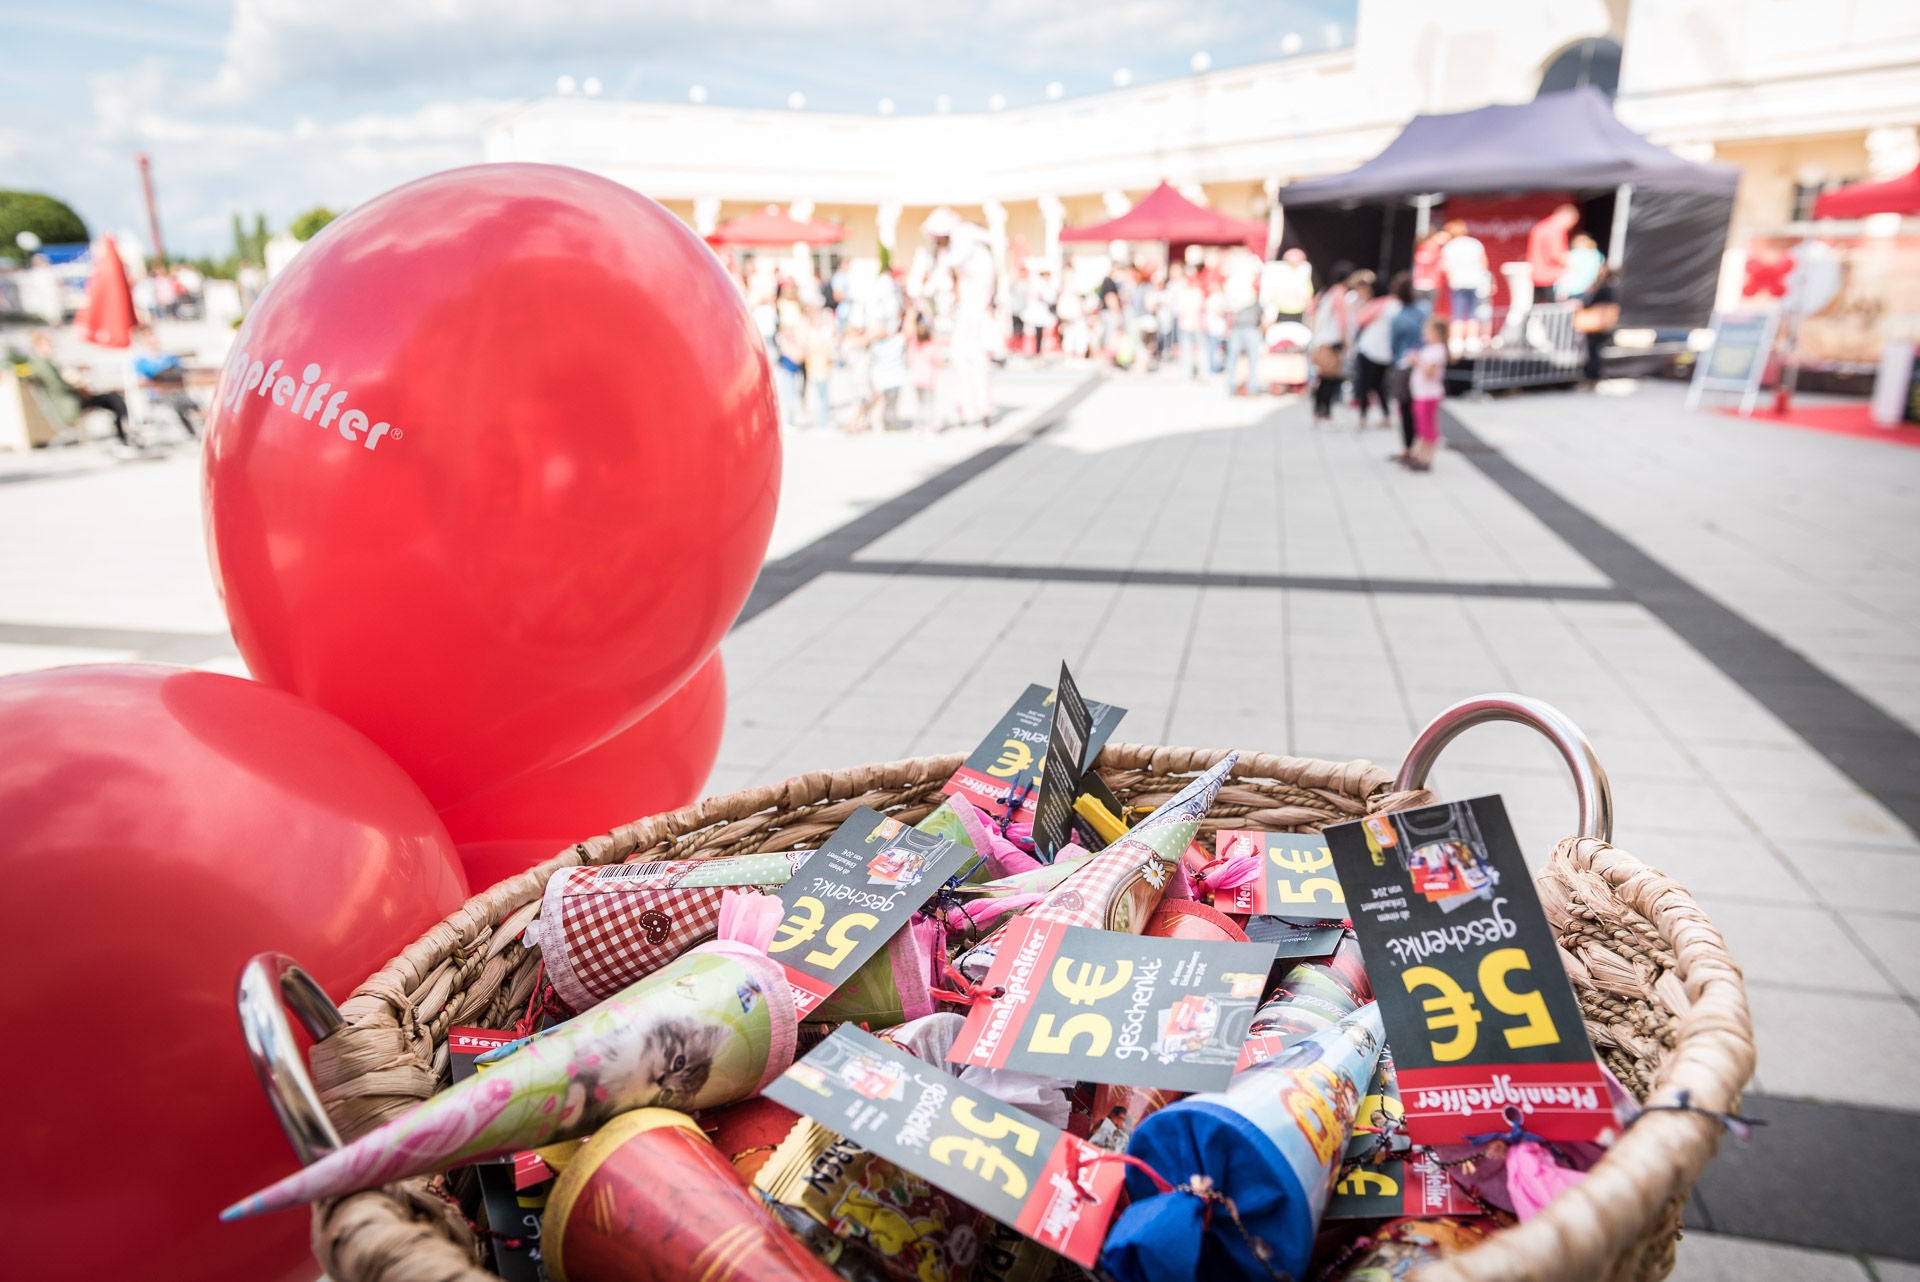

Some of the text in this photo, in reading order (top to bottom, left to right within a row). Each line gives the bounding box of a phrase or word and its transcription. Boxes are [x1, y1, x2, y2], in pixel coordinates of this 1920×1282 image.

[224, 347, 391, 451] gpfeiffer
[813, 876, 907, 913] geschenkt
[1385, 897, 1517, 966] geschenkt
[1114, 956, 1162, 1062] geschenkt
[1419, 1073, 1599, 1117] Pfennigpfeiffer
